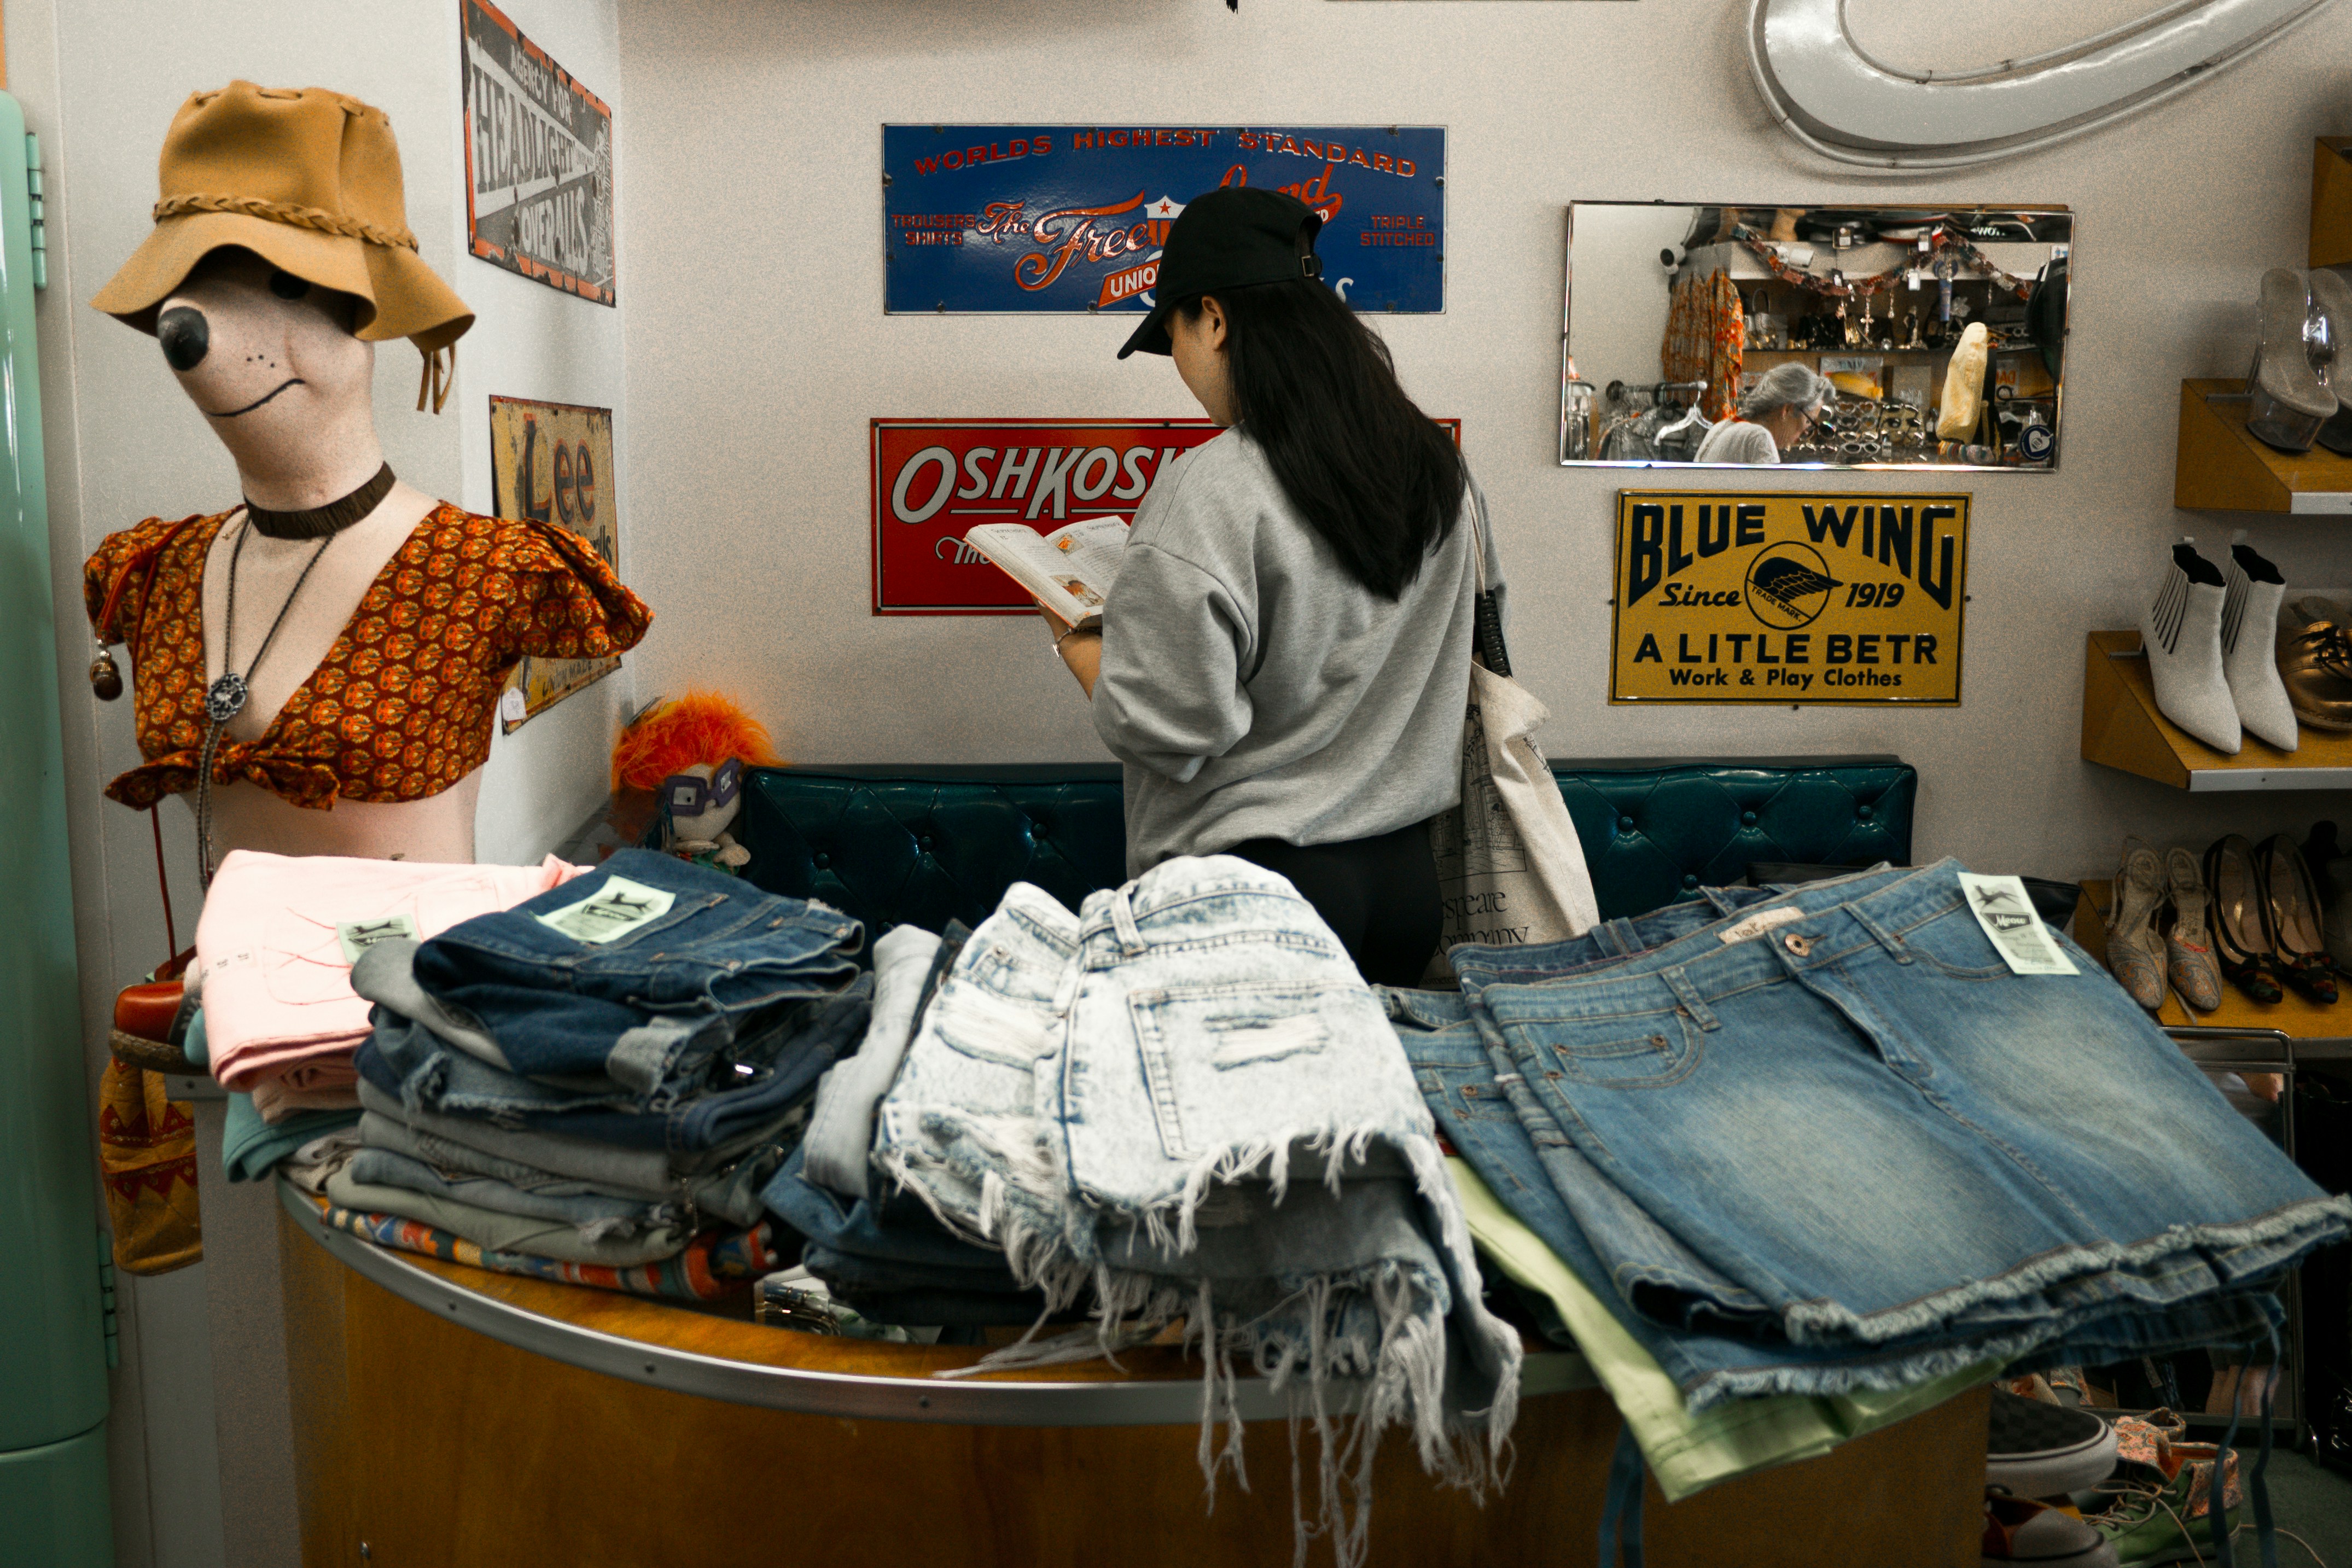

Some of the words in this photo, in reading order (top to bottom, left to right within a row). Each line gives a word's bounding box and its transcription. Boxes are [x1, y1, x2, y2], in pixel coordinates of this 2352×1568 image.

[510, 44, 548, 105] AGENCY
[552, 81, 573, 126] FOR
[472, 62, 574, 194] HEADLIGHT
[914, 136, 1052, 176] WORLDS
[1073, 129, 1218, 150] HIGHEST
[1239, 132, 1417, 178] STANDARD
[521, 185, 588, 276] OVERALLS
[892, 214, 976, 229] TROUSERS
[1371, 215, 1425, 229] TRIPLE
[905, 231, 963, 245] SHIRTS
[976, 200, 1029, 244] The
[1015, 190, 1152, 292] Free
[1360, 232, 1435, 246] STITCHED
[1110, 265, 1160, 297] UNIO
[523, 413, 595, 530] Lee
[1628, 503, 1766, 609] BLUE
[1801, 504, 1955, 610] WING
[1658, 582, 1742, 607] Since
[1845, 582, 1905, 608] 1919
[1751, 585, 1777, 605] TRADE
[1633, 633, 1663, 662] A
[1679, 633, 1810, 663] LITLE
[1826, 633, 1937, 664] BETR
[1669, 668, 1728, 686] Work
[1739, 669, 1755, 686] &
[1767, 668, 1814, 691] Play
[1824, 668, 1902, 687] Clothes
[1996, 914, 2026, 927] Meow
